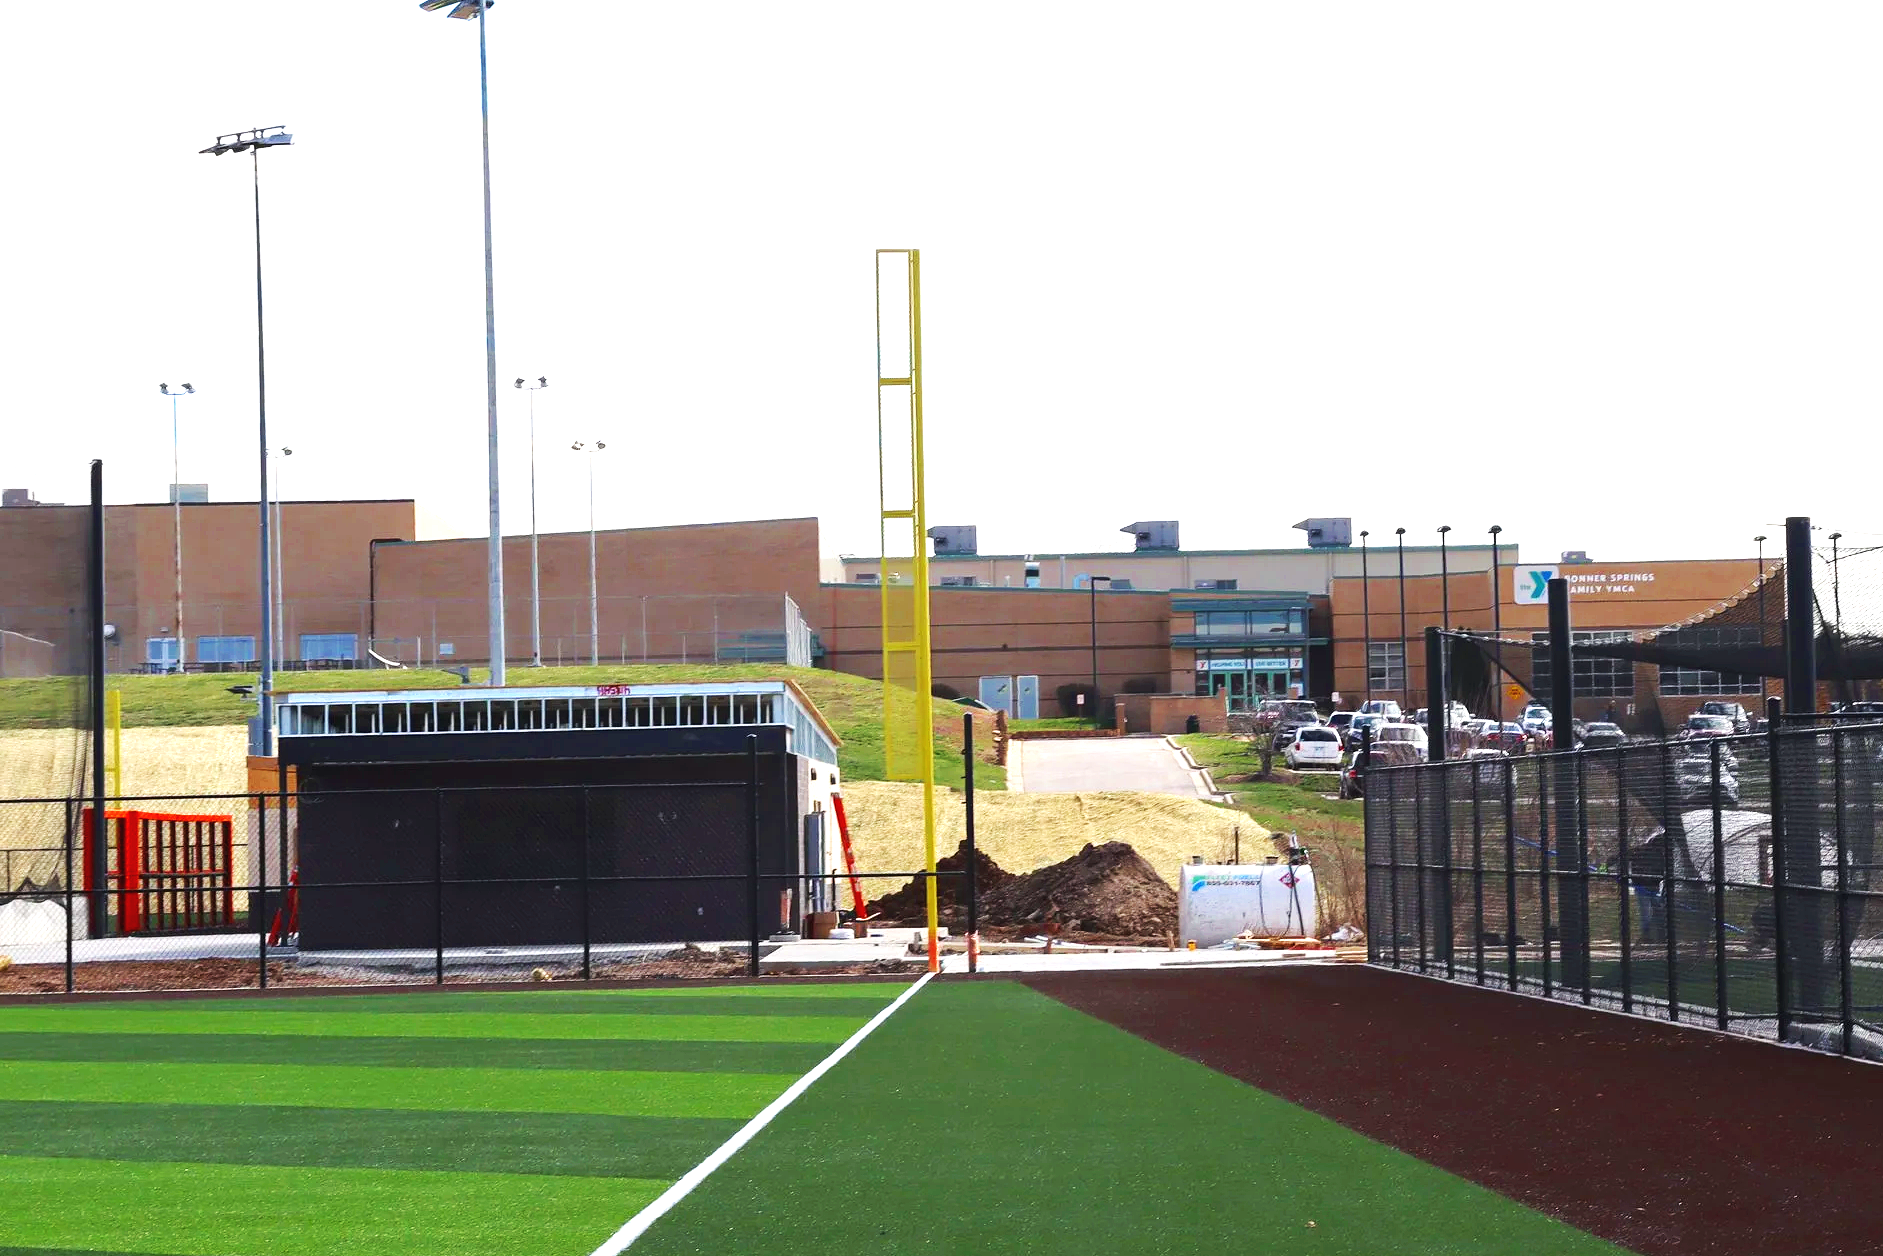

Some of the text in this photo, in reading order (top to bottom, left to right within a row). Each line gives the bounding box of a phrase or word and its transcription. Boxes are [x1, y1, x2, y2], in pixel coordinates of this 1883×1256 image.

[1611, 573, 1655, 582] SPRINGS
[1568, 585, 1635, 594] AMILY YMCA
